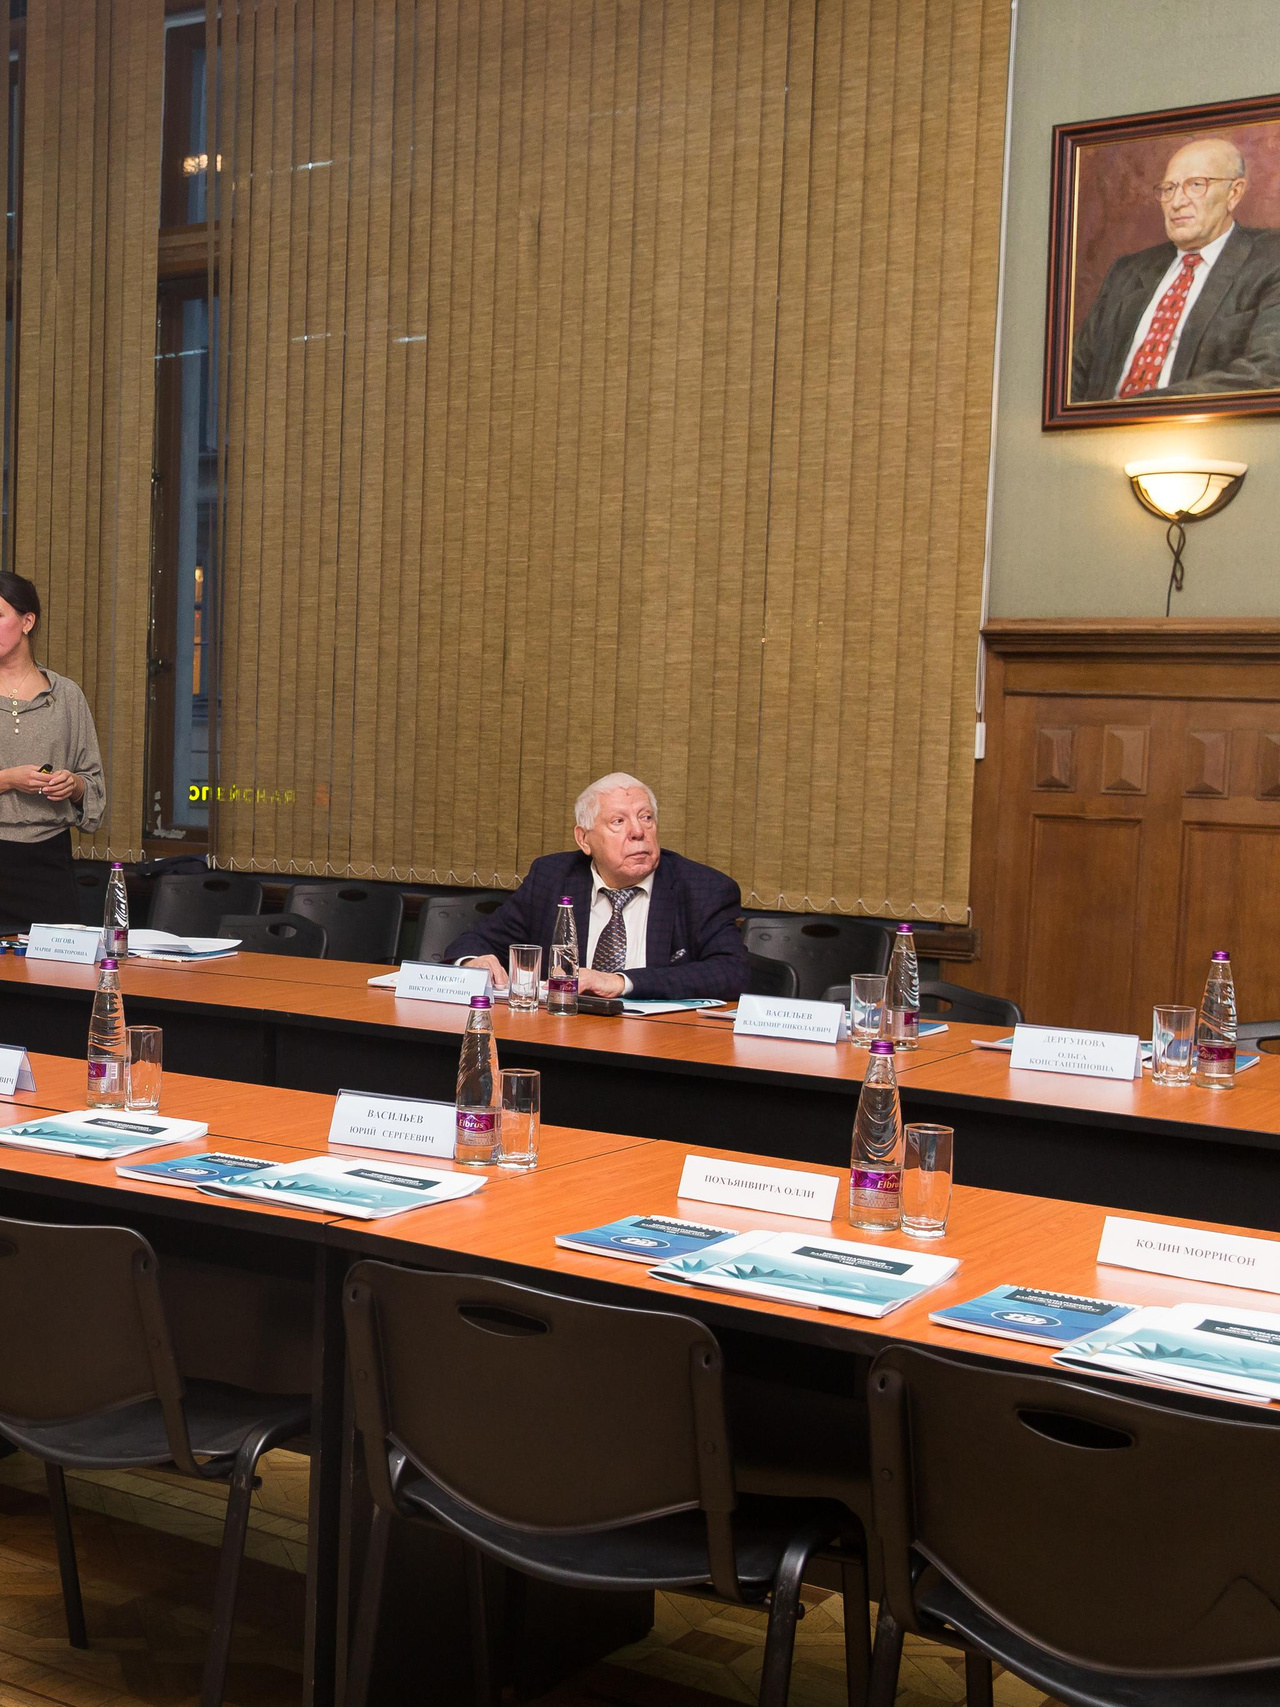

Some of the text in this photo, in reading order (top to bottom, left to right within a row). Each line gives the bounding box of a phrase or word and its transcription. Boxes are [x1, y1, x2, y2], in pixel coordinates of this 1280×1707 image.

[408, 985, 471, 996] ВИКТОР ПЕТРОВИЧ
[765, 1010, 813, 1020] ВАСИЛЬЕВ
[742, 1020, 832, 1033] ВЛАДИМИР НИКОЛАЕВИЧ
[1042, 1035, 1106, 1048] ДЕРГУНОВА
[1057, 1052, 1087, 1061] ОЛЬГА
[1029, 1058, 1115, 1073] КОНСТАНТИНОВНА
[367, 1109, 424, 1124] ВАСИЛЬЕВ
[459, 1119, 484, 1129] Elbrus
[349, 1126, 435, 1144] ЮРИЙ СЕРГЕЕВИЧ
[704, 1174, 816, 1199] ПОХЪЯНВИРТА ОЛЛИ
[1136, 1239, 1256, 1267] КОЛИН МОРРИСОН
